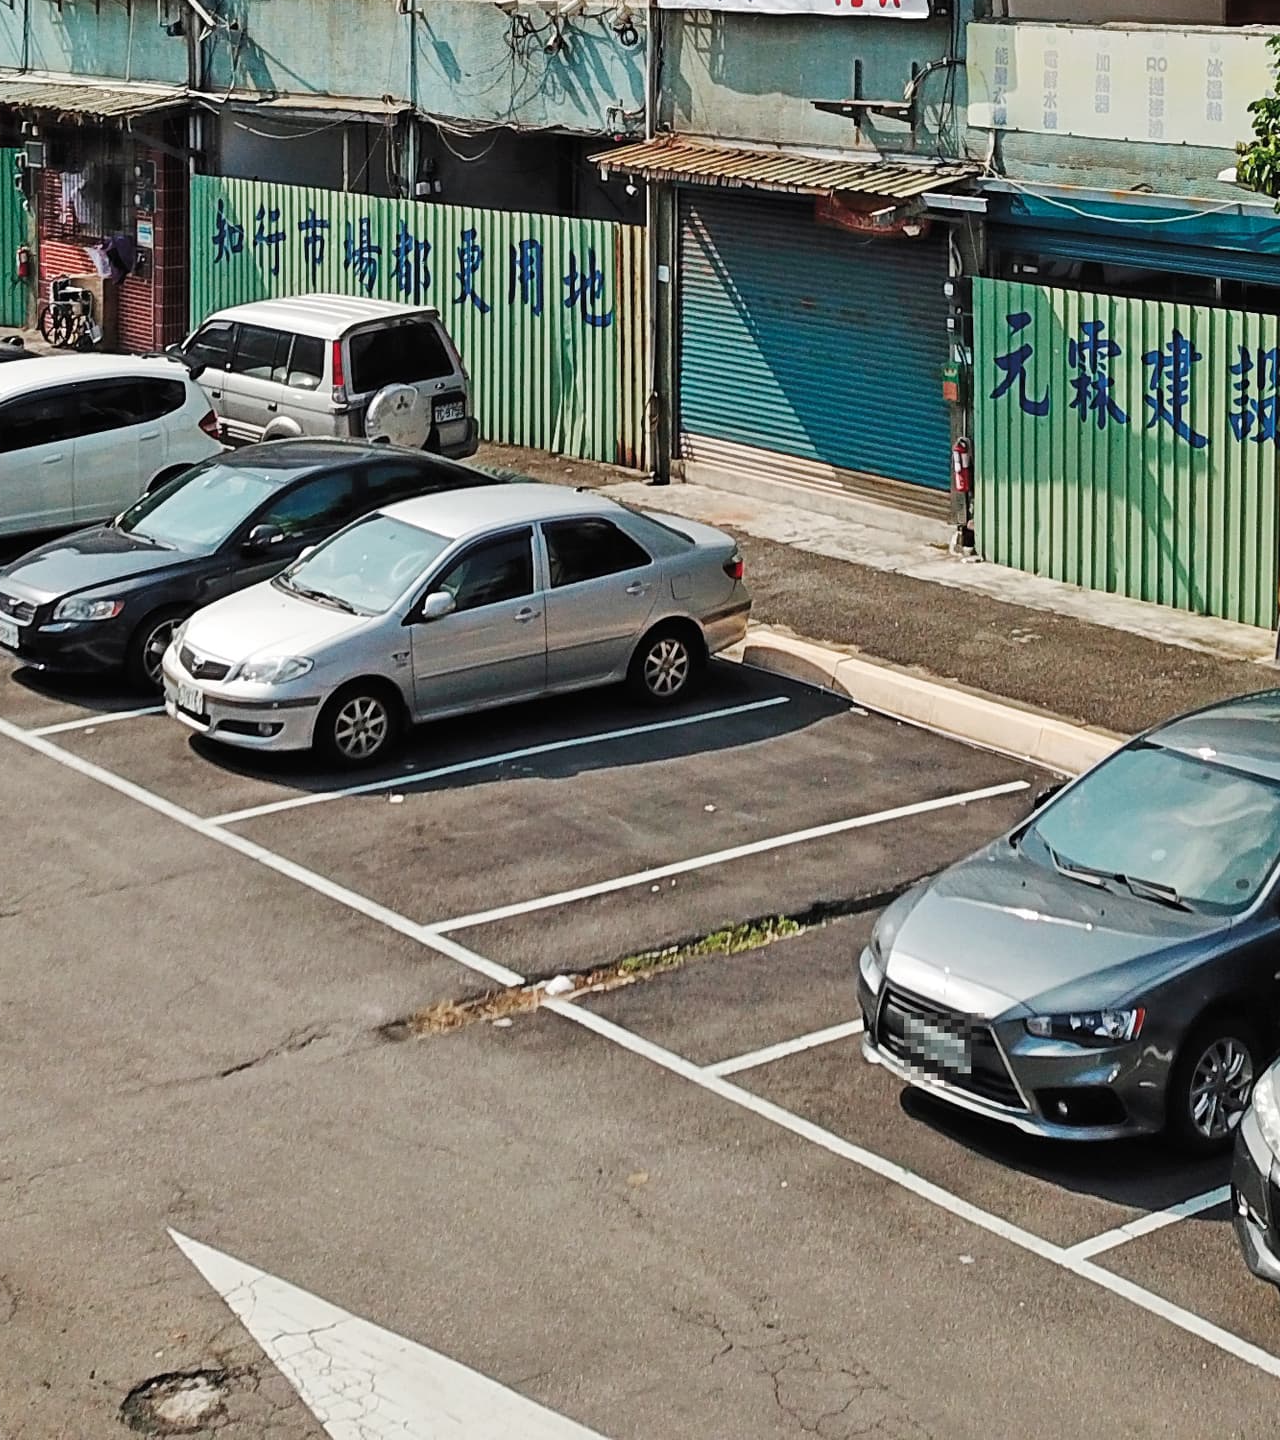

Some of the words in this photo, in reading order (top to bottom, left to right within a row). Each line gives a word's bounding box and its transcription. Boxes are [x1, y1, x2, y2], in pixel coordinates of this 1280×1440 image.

[212, 198, 613, 328] 知行市場都更用地
